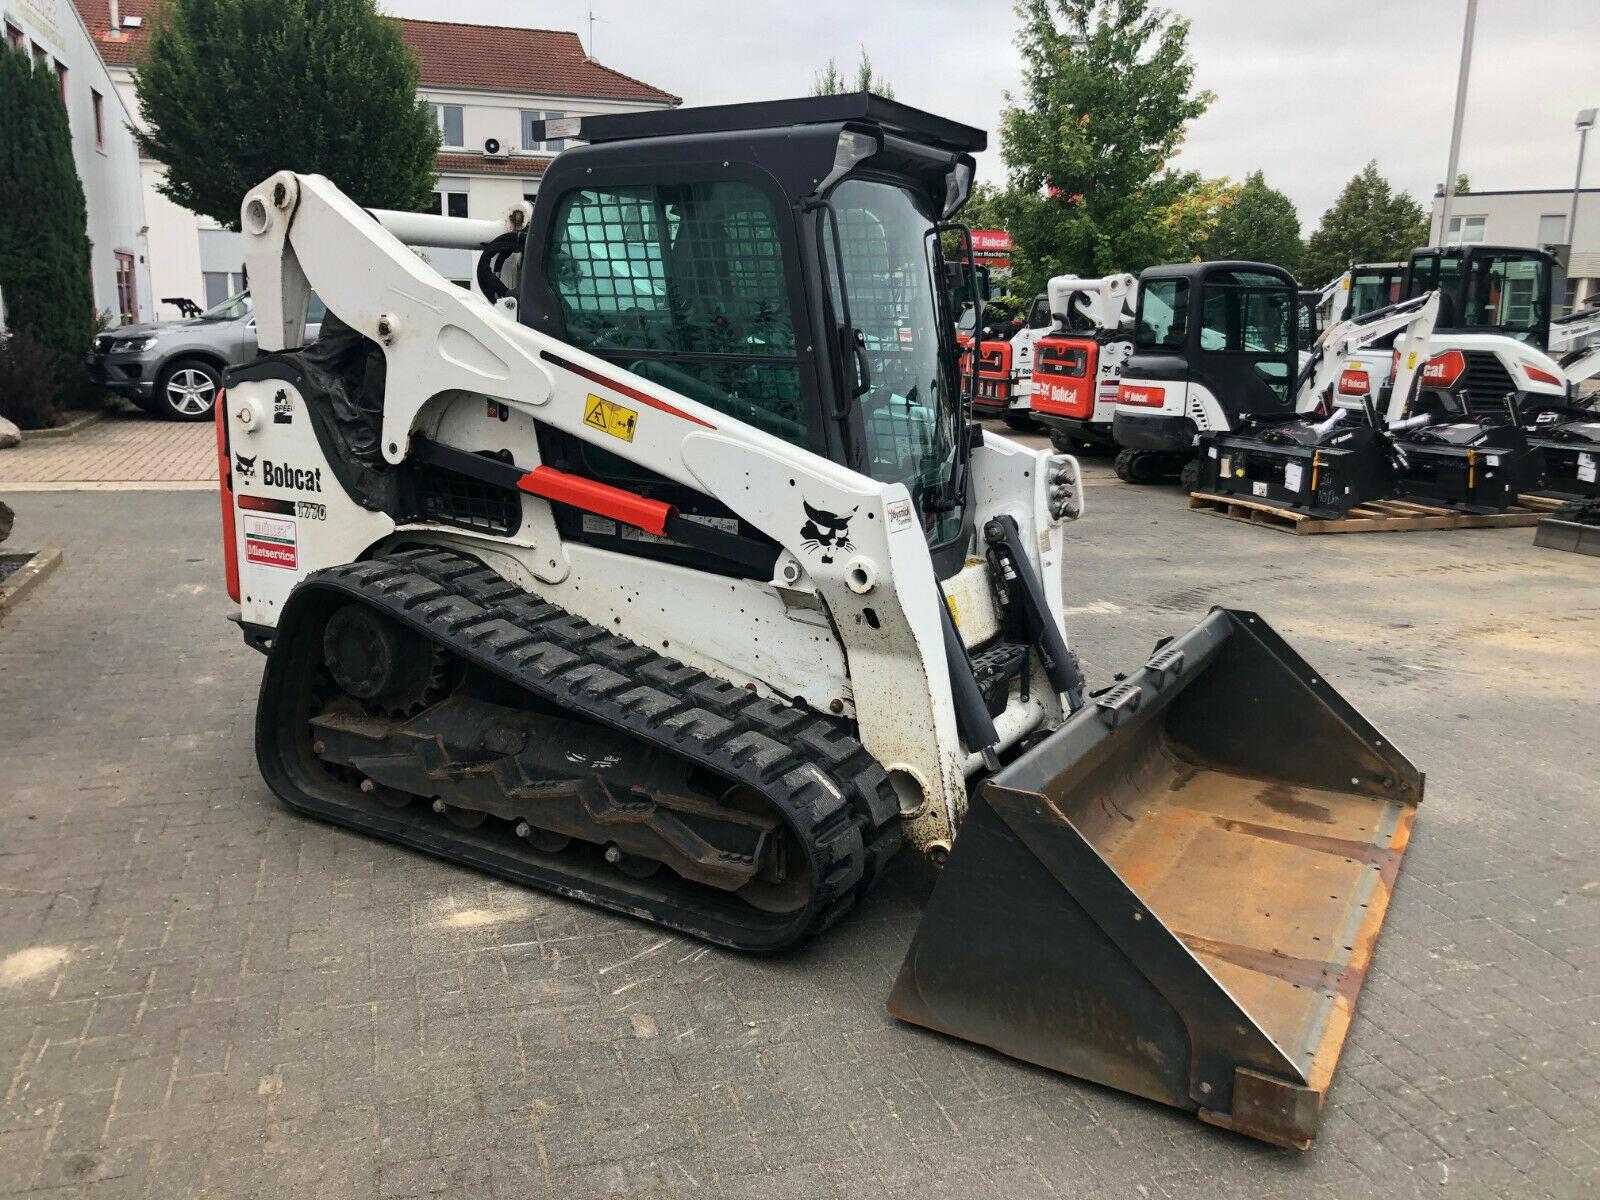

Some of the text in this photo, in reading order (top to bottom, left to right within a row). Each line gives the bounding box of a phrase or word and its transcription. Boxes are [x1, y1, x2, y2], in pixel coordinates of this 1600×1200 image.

[982, 237, 1008, 247] Bobcat
[1020, 346, 1029, 357] 2
[1423, 363, 1445, 378] cat
[1348, 378, 1367, 389] Bobcat
[1051, 385, 1078, 405] Bobcat
[1130, 392, 1148, 403] Bobcat
[263, 460, 322, 493] Bobcat
[297, 500, 327, 521] T770
[889, 506, 911, 522] Joystick
[248, 544, 295, 563] Mietservice
